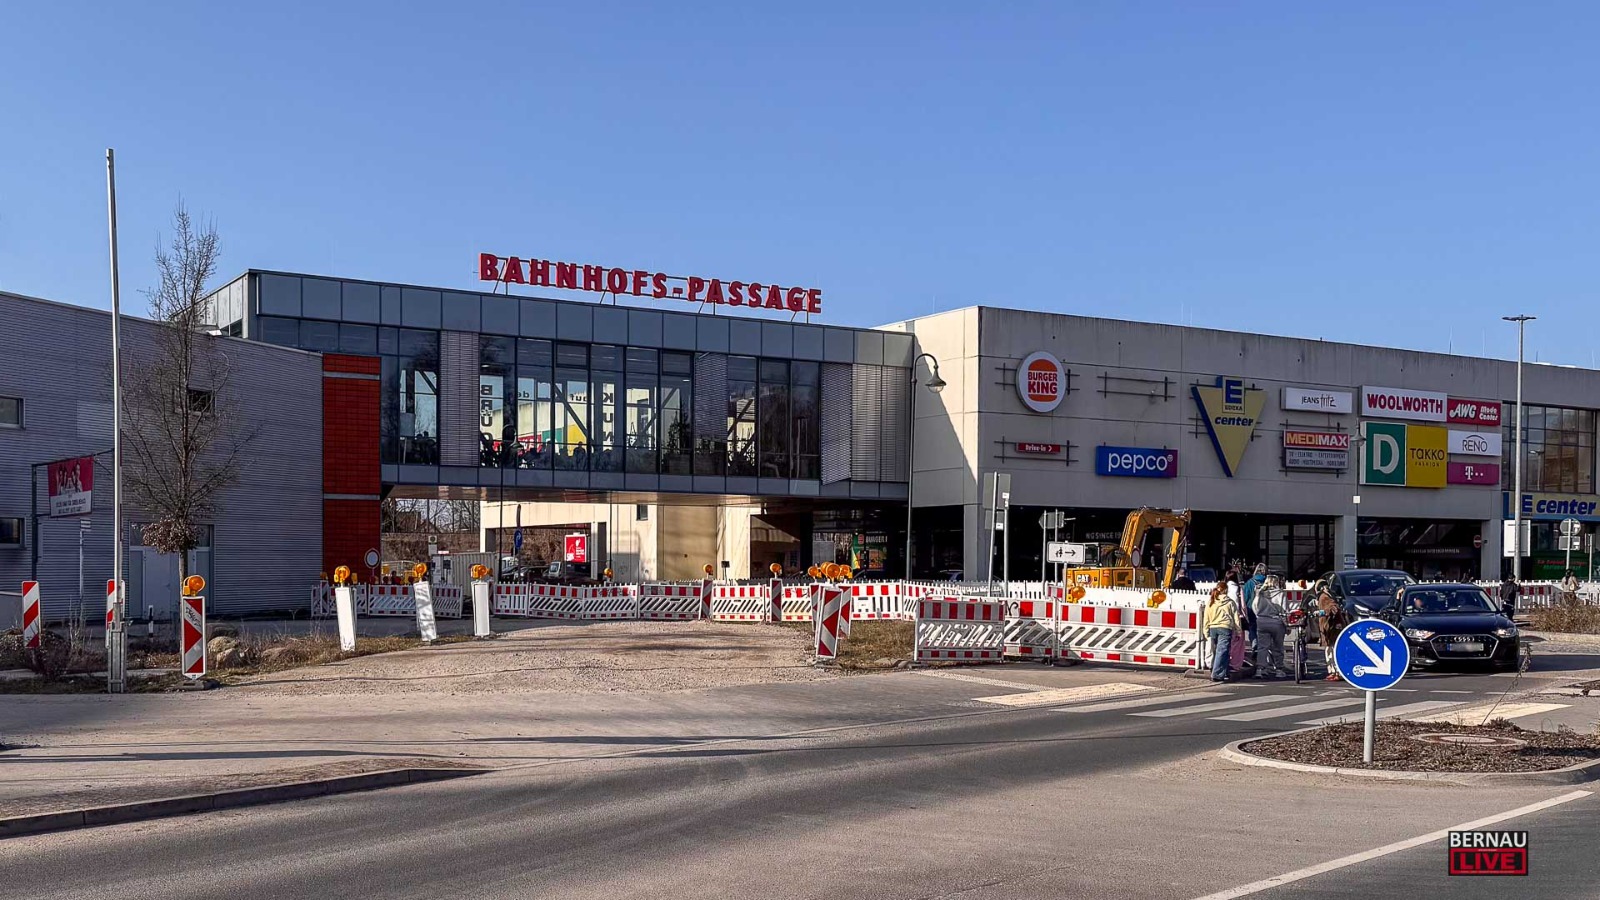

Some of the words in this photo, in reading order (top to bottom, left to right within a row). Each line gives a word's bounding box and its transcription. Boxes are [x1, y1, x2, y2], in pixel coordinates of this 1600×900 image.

[480, 253, 822, 314] BAHNHOFS-PASSAGE
[1028, 371, 1058, 382] BURGER
[1027, 381, 1058, 394] KING
[1225, 379, 1242, 404] E
[1301, 396, 1320, 404] JEANS
[1366, 393, 1443, 414] WOOLWORTH
[1449, 402, 1477, 419] AWG
[1480, 405, 1498, 414] Mode
[1214, 416, 1254, 427] center
[1479, 412, 1499, 421] Center
[1286, 432, 1348, 447] MEDIMAX
[1462, 440, 1488, 453] RENO
[1373, 433, 1400, 475] D
[1536, 499, 1597, 515] center
[1077, 574, 1090, 583] CAT
